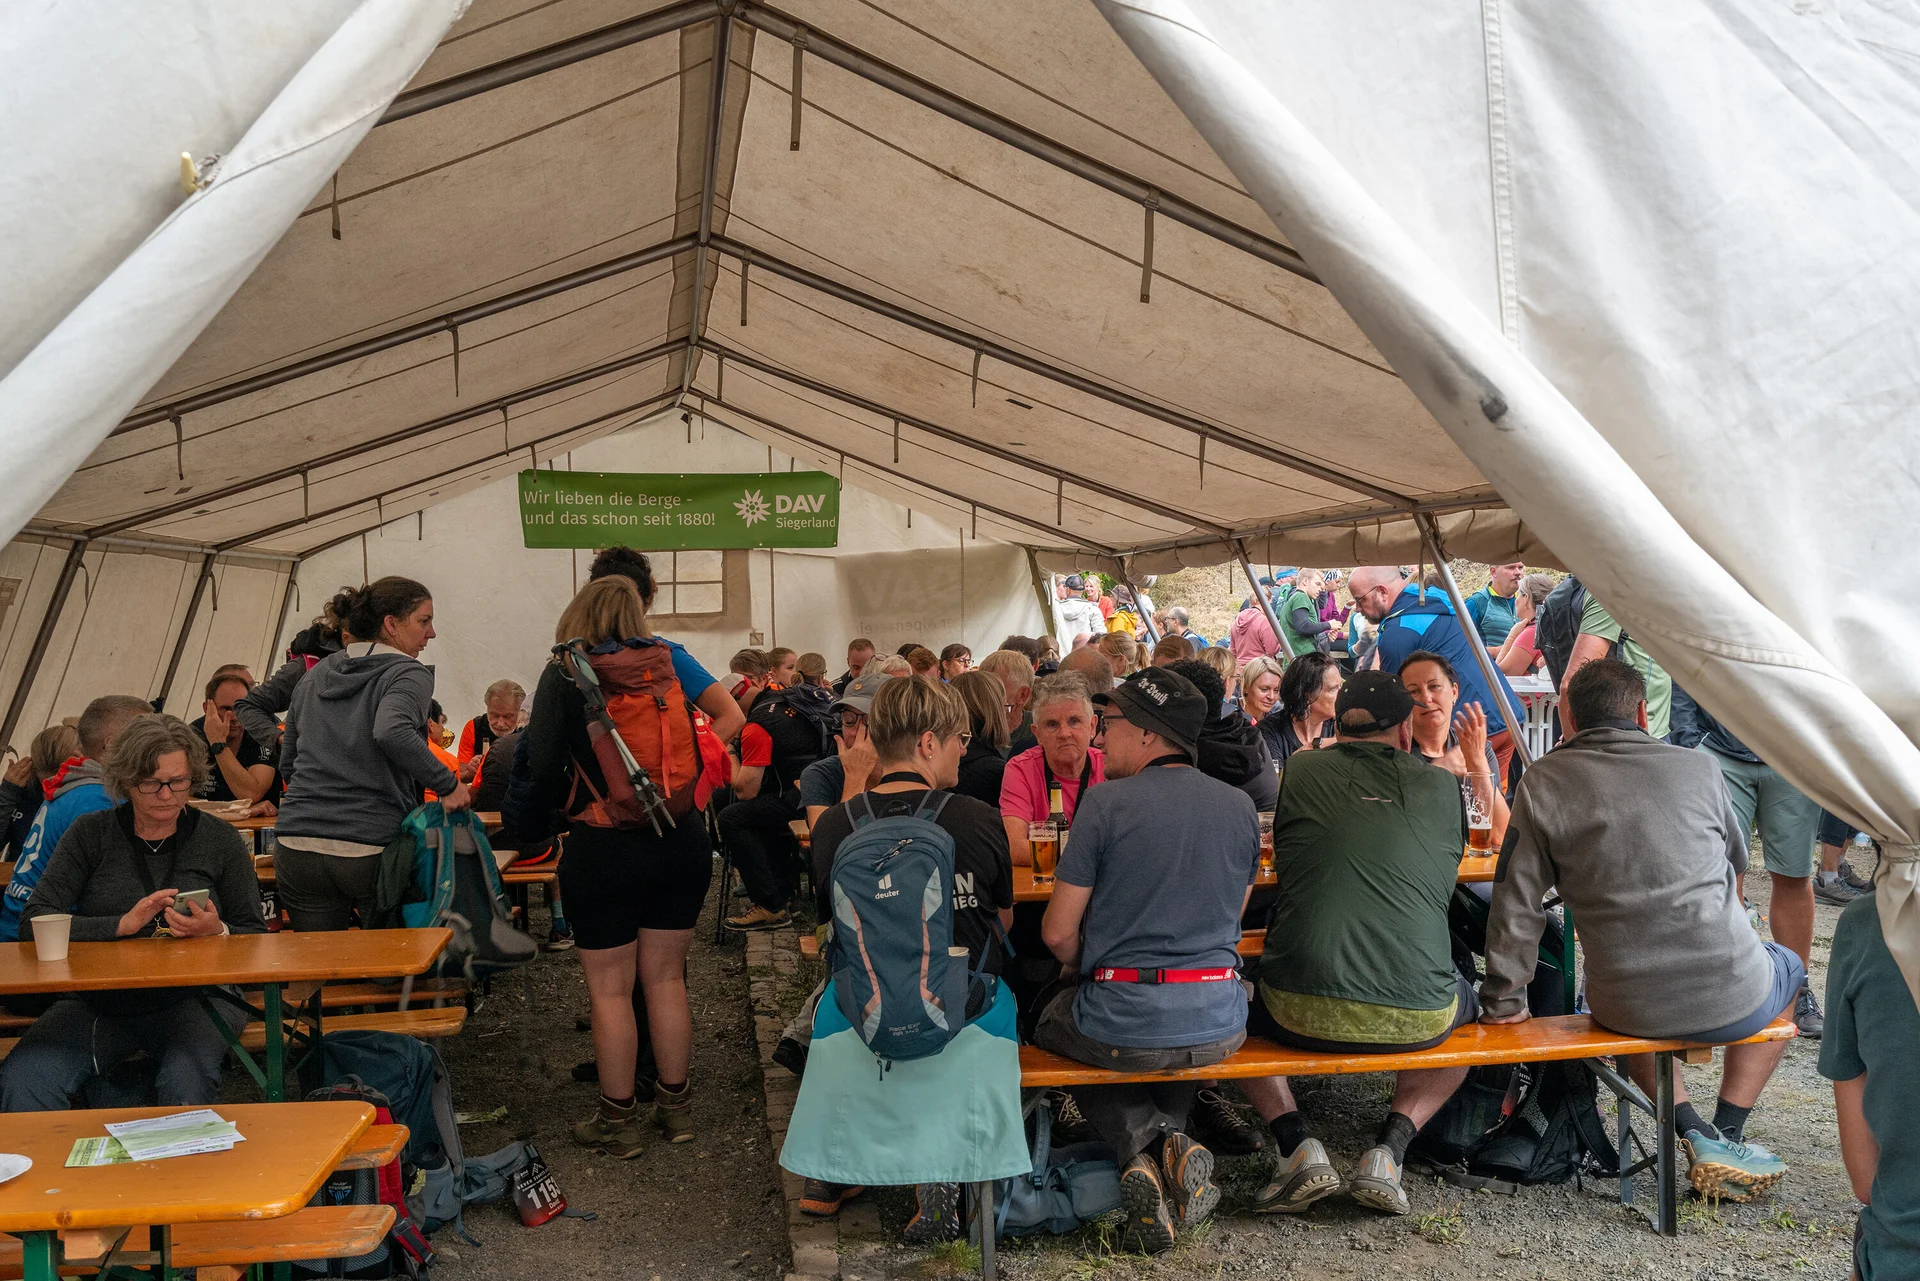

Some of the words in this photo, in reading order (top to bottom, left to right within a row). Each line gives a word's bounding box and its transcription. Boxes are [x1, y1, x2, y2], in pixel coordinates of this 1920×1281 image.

[523, 490, 550, 505] Wir
[555, 490, 604, 506] lieben
[608, 491, 633, 506] die
[638, 493, 681, 510] Berge
[775, 493, 826, 514] DAV
[525, 510, 555, 525] und
[560, 510, 588, 525] das
[592, 511, 638, 526] schon
[643, 511, 672, 526] seit
[676, 512, 716, 527] 1880!
[775, 516, 836, 531] Siegerland
[1147, 683, 1170, 706] Death
[874, 889, 900, 901] deuter
[516, 1178, 533, 1190] SEVEN
